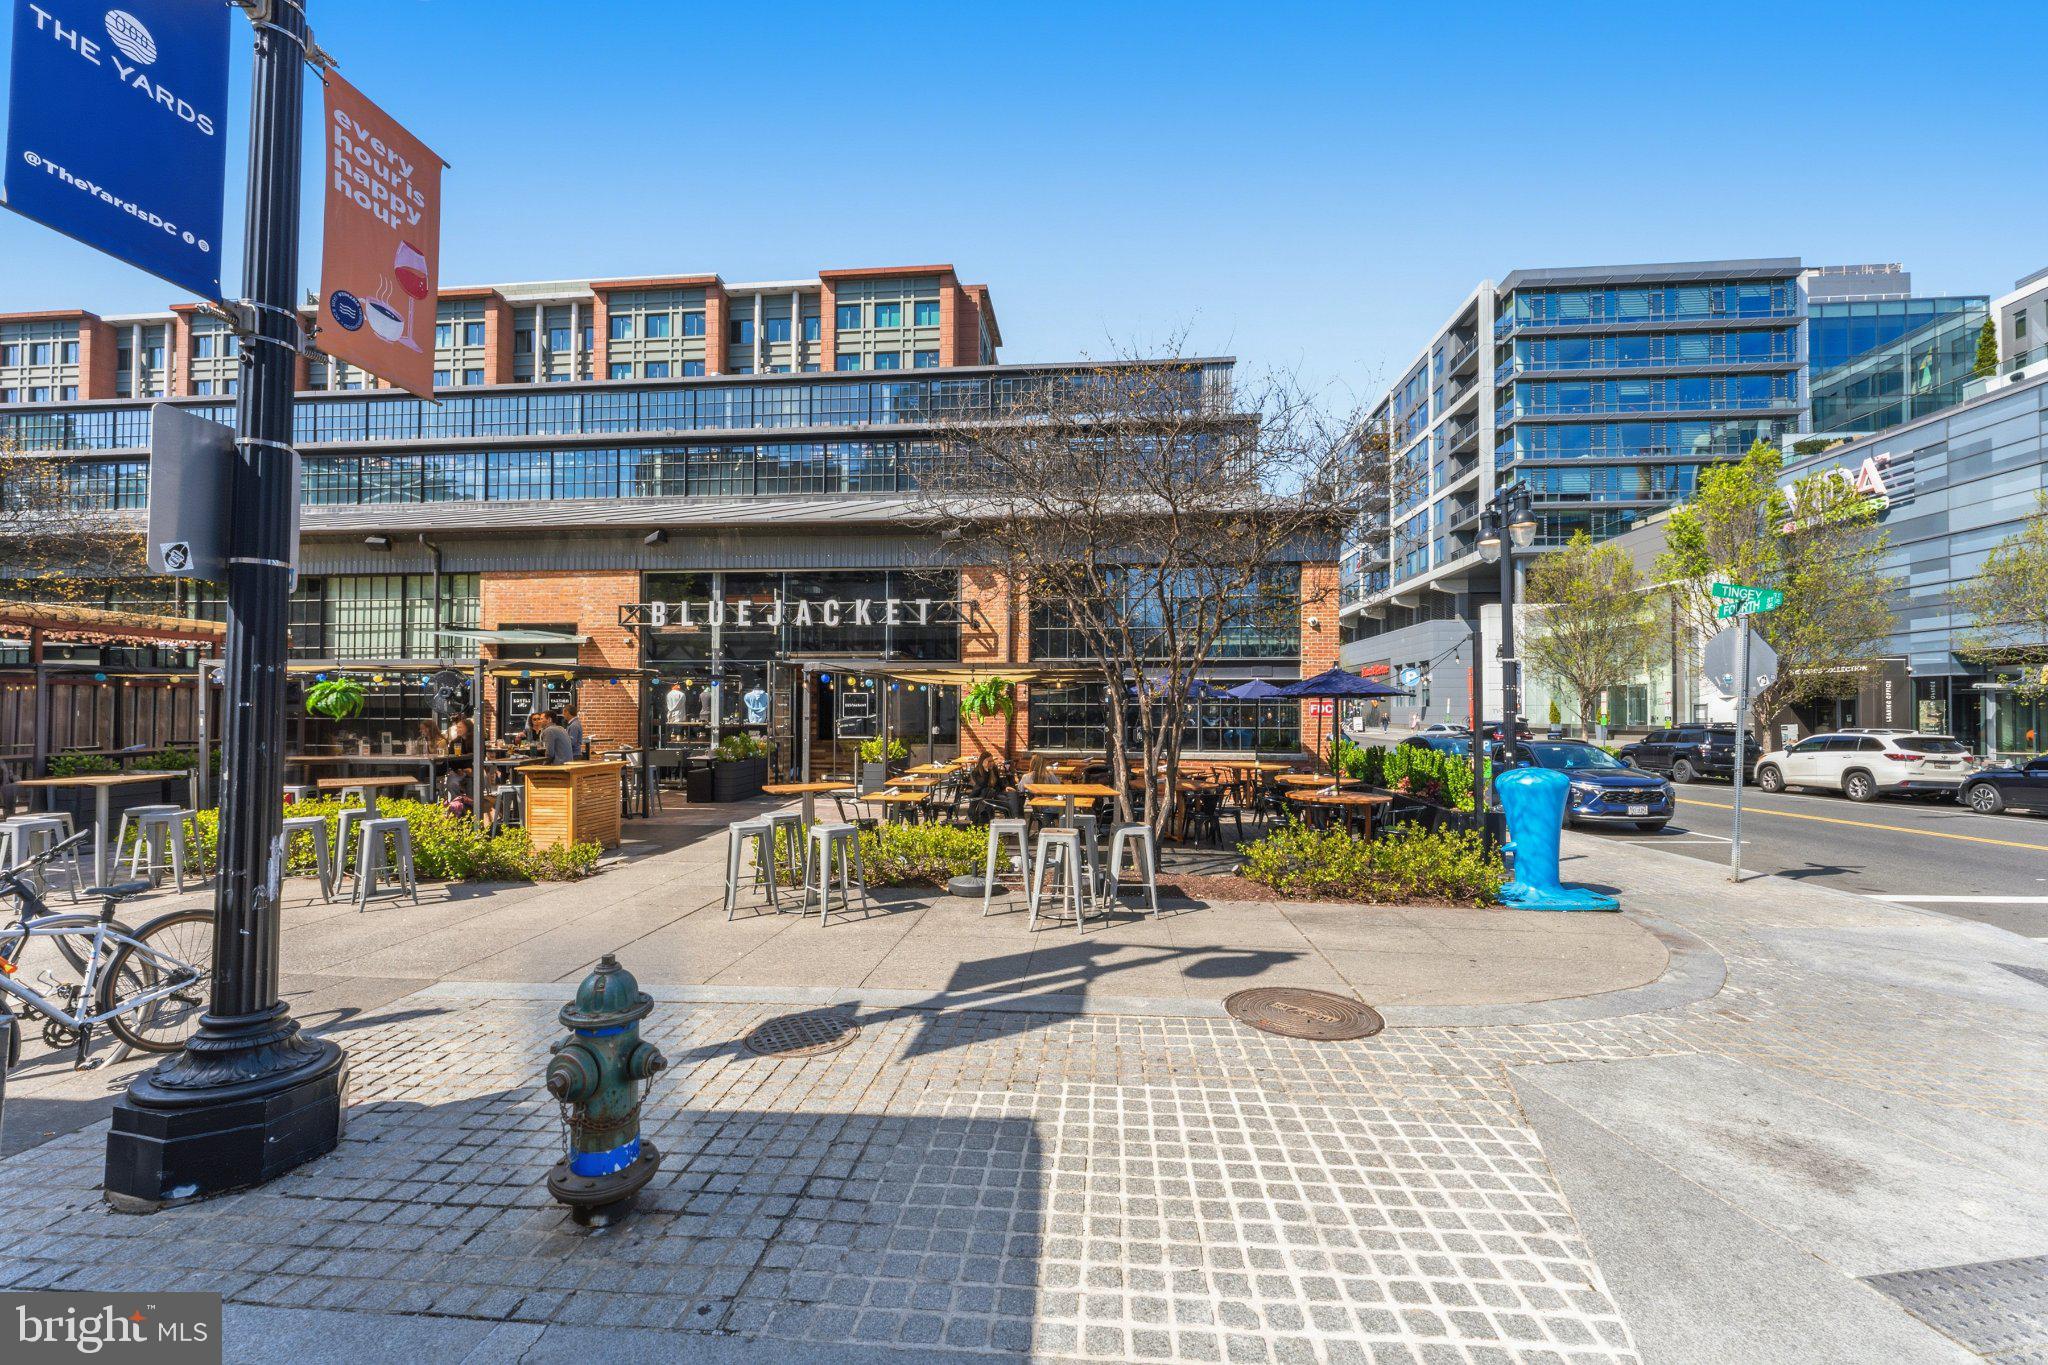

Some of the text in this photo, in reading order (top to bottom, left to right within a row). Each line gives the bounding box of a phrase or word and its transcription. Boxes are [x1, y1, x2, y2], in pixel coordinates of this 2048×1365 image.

[29, 3, 214, 136] THE YARDS
[333, 109, 414, 178] every
[334, 124, 425, 208] hour is
[23, 150, 177, 236] @TheYardsDC
[334, 146, 422, 226] happy
[334, 169, 402, 230] hour
[651, 598, 931, 628] BLUEJACKET
[1722, 585, 1763, 601] TINGEY
[1723, 600, 1761, 616] FOURTH
